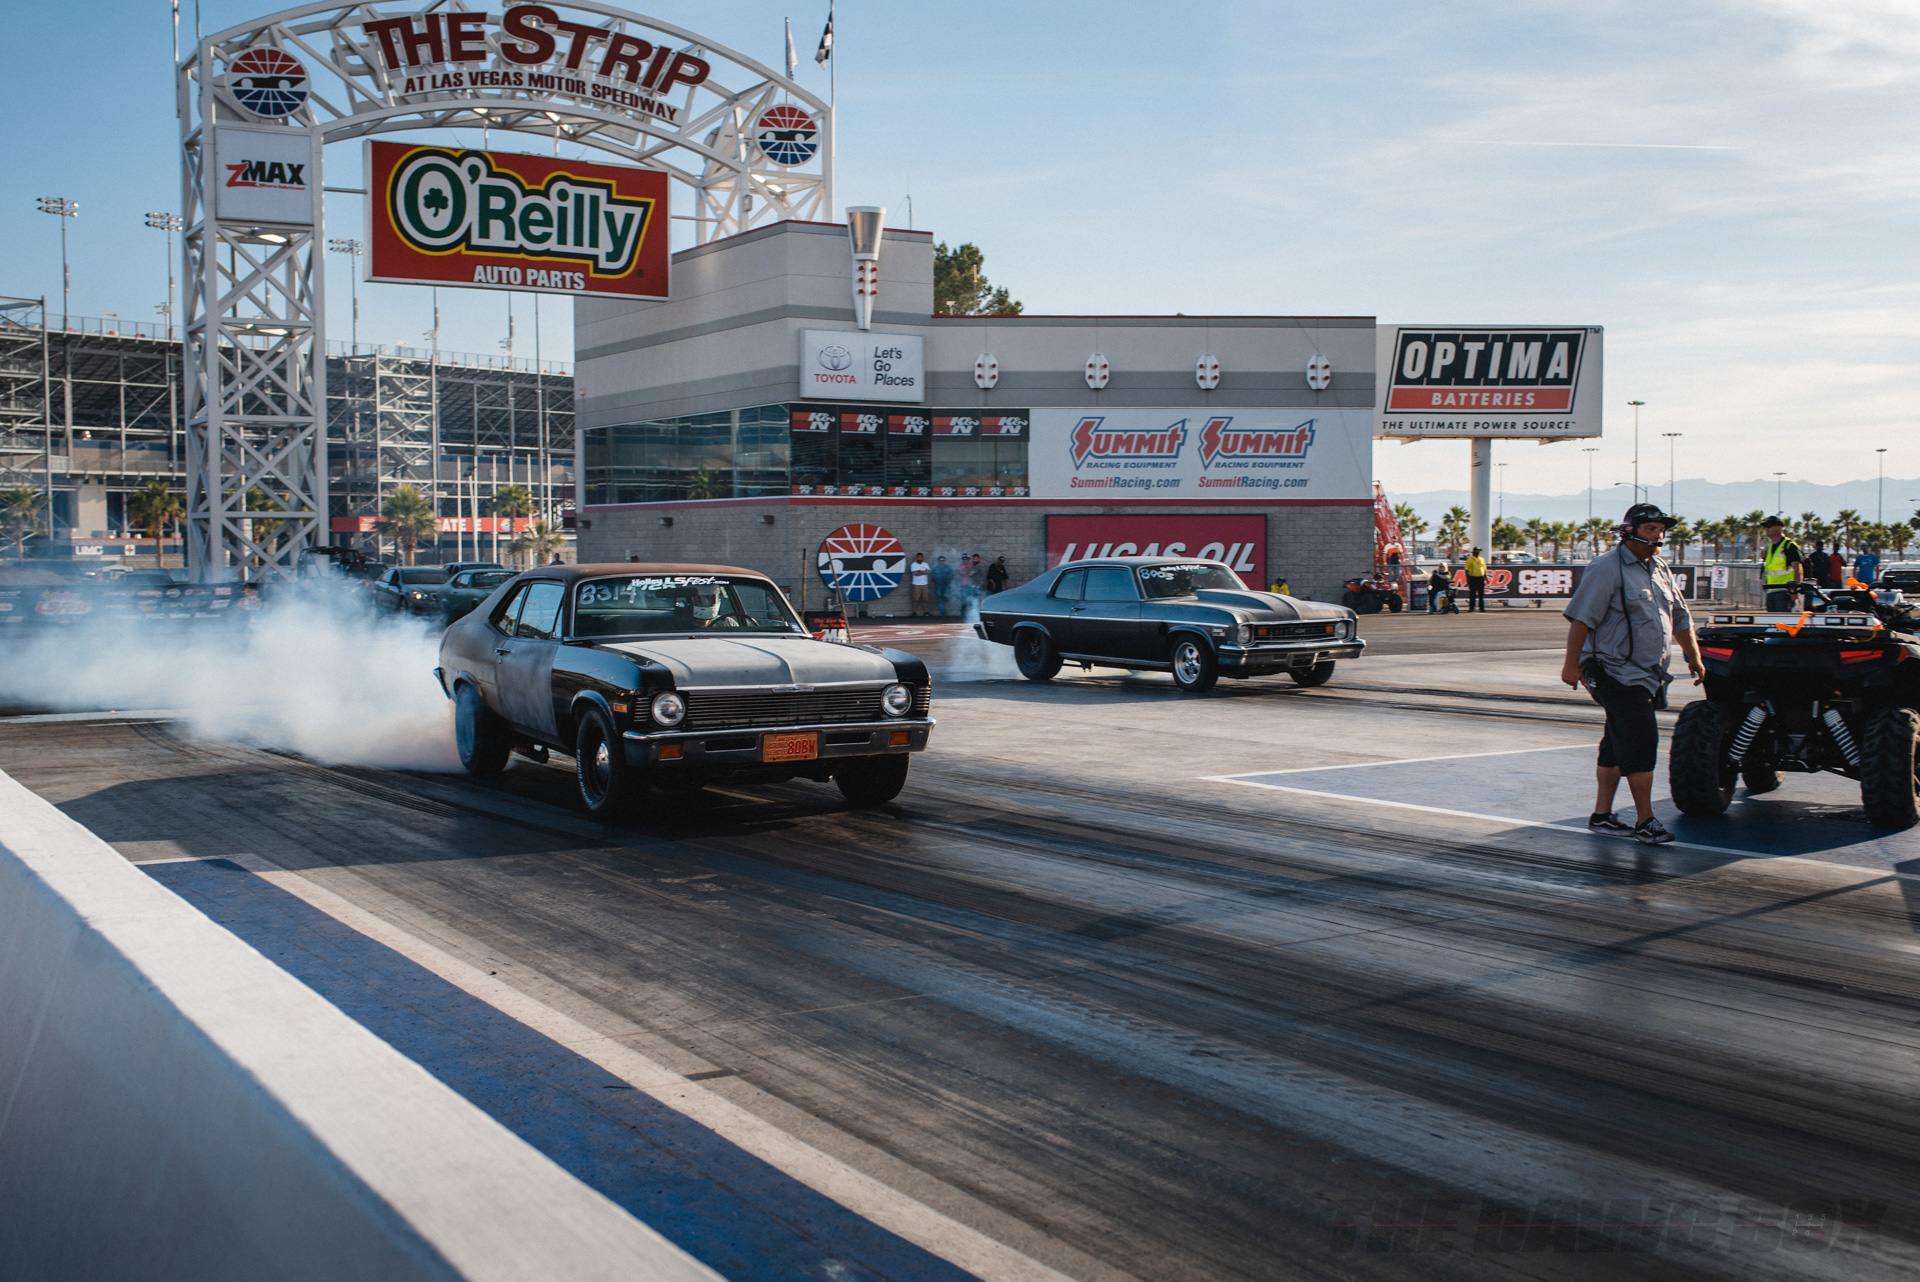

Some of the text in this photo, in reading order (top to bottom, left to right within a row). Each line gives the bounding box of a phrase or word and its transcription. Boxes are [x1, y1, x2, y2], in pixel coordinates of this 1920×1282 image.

[362, 2, 711, 96] THE STRIP
[404, 70, 679, 122] AT LAS VEGAS MOTOR SPEEDWAY
[398, 154, 645, 269] O'Reilly
[473, 264, 586, 290] AUTO PARTS
[873, 346, 903, 359] Let's
[873, 360, 892, 372] Go
[1402, 340, 1569, 380] OPTIMA
[813, 373, 857, 384] TOYOTA
[874, 373, 915, 386] Places
[1431, 392, 1536, 406] BATTERIES
[1382, 421, 1571, 430] THE ULTIMATE POWER SOURCE
[1086, 461, 1178, 469] RACING EQUIPMENT
[1214, 461, 1305, 469] RACING EQUIPMENT
[1070, 476, 1180, 490] SummitRacing.com
[1198, 476, 1308, 490] SummitRacing.com
[1190, 542, 1257, 572] OIL
[632, 578, 662, 587] Holley
[1518, 569, 1573, 584] CAR
[1518, 583, 1573, 595] CRAFT
